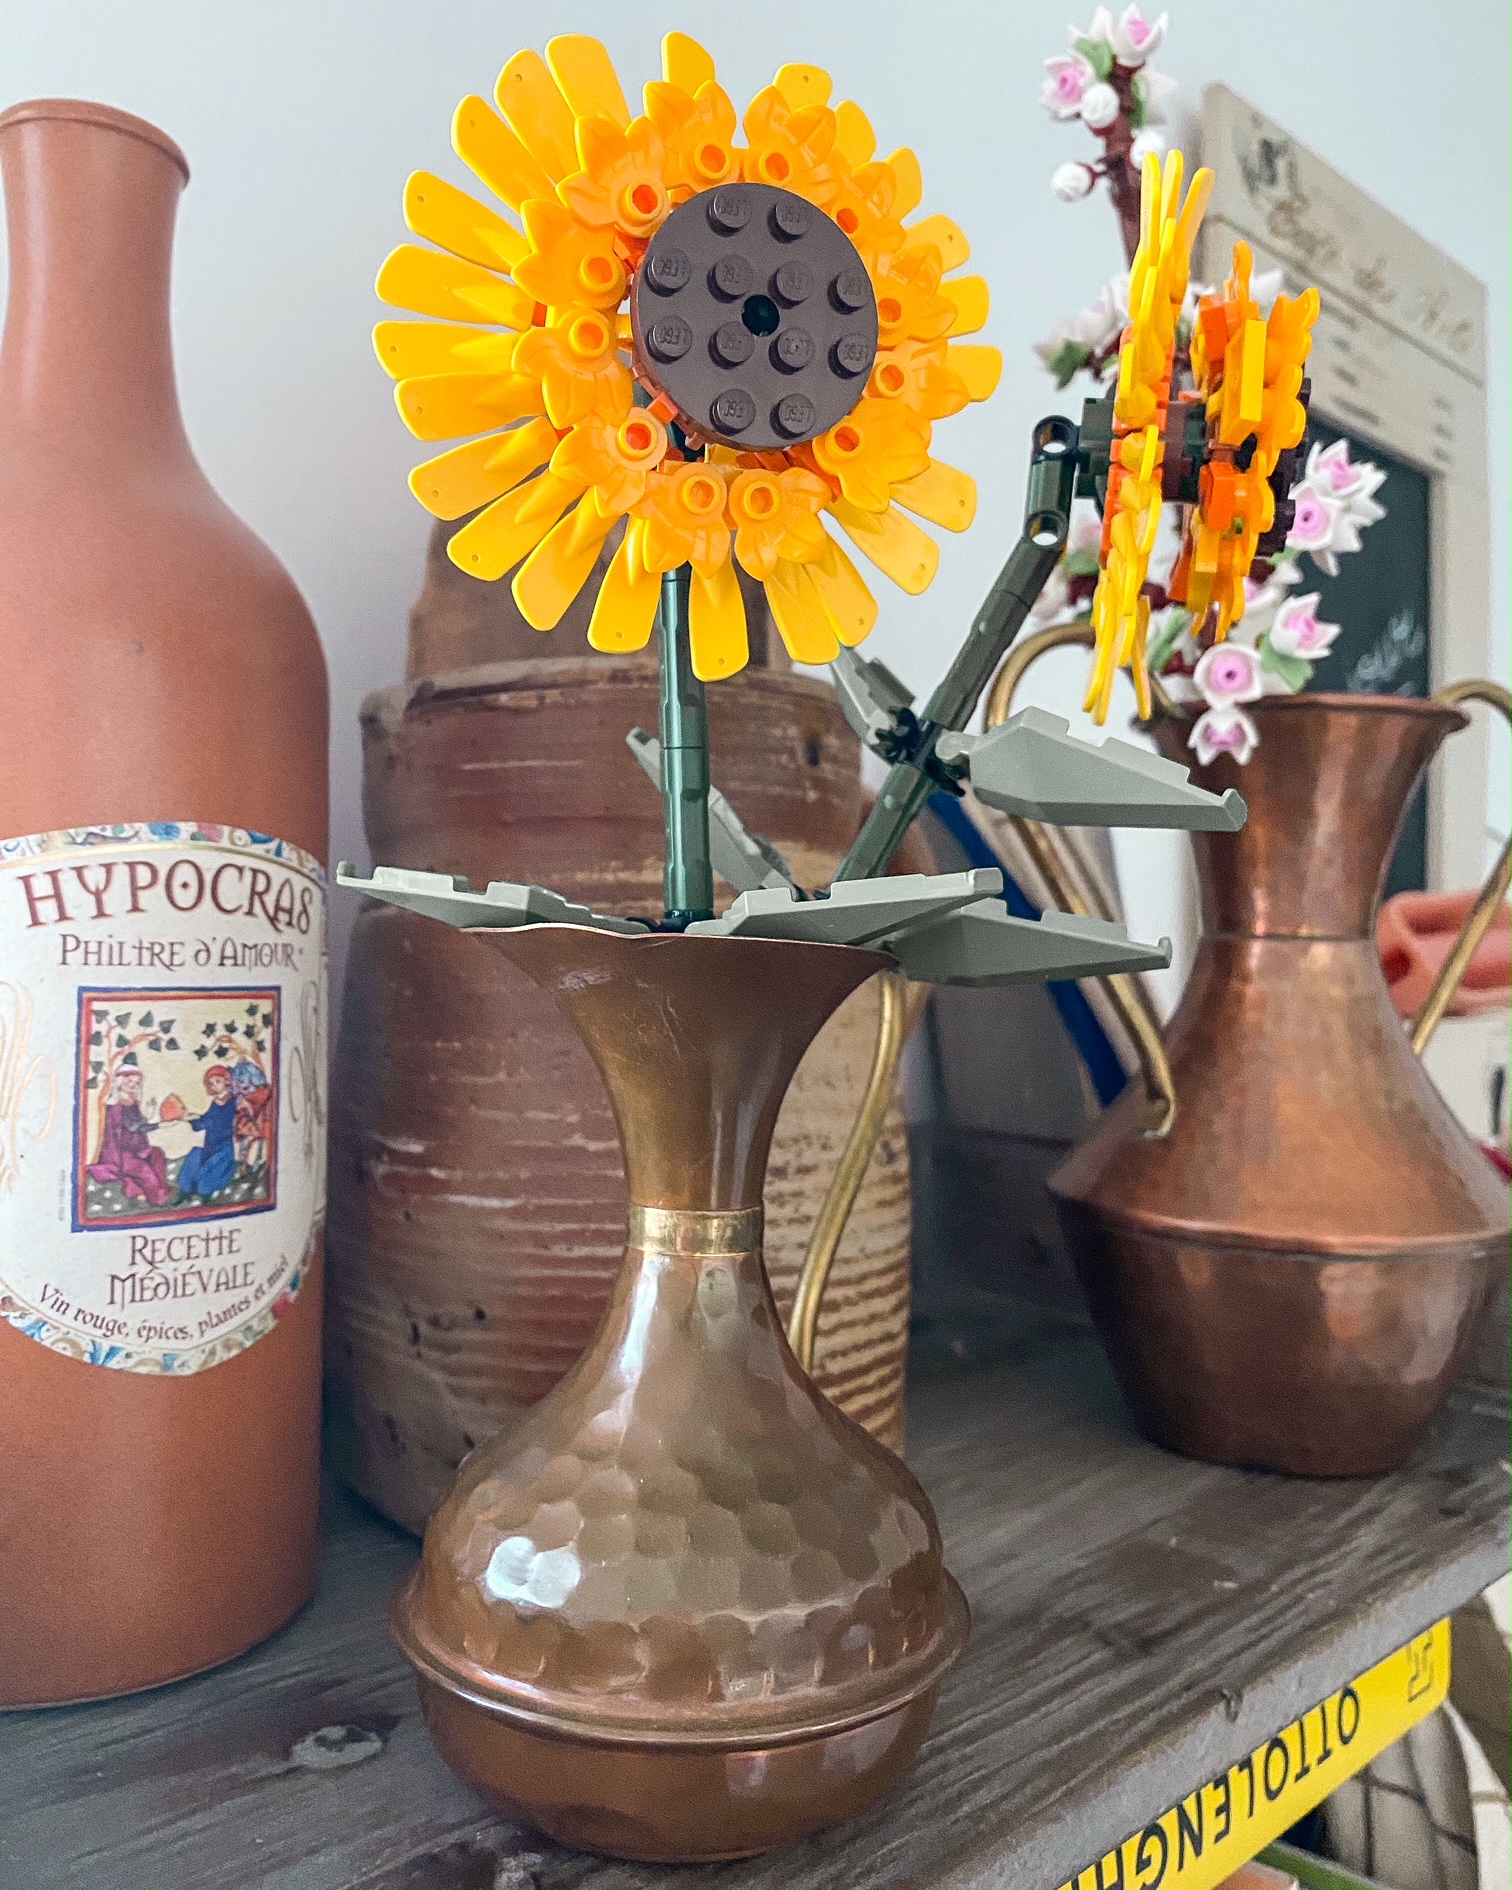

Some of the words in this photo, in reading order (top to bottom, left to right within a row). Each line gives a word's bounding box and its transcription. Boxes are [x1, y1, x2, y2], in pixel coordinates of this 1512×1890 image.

[17, 859, 313, 935] HYPOCRAS
[128, 1228, 242, 1269] RECETTE
[40, 1283, 70, 1315] Vin
[73, 1307, 130, 1338] rouge,
[198, 1295, 251, 1337] plantes
[254, 1283, 266, 1301] et
[1070, 1687, 1360, 1890] OTTOLENGH
